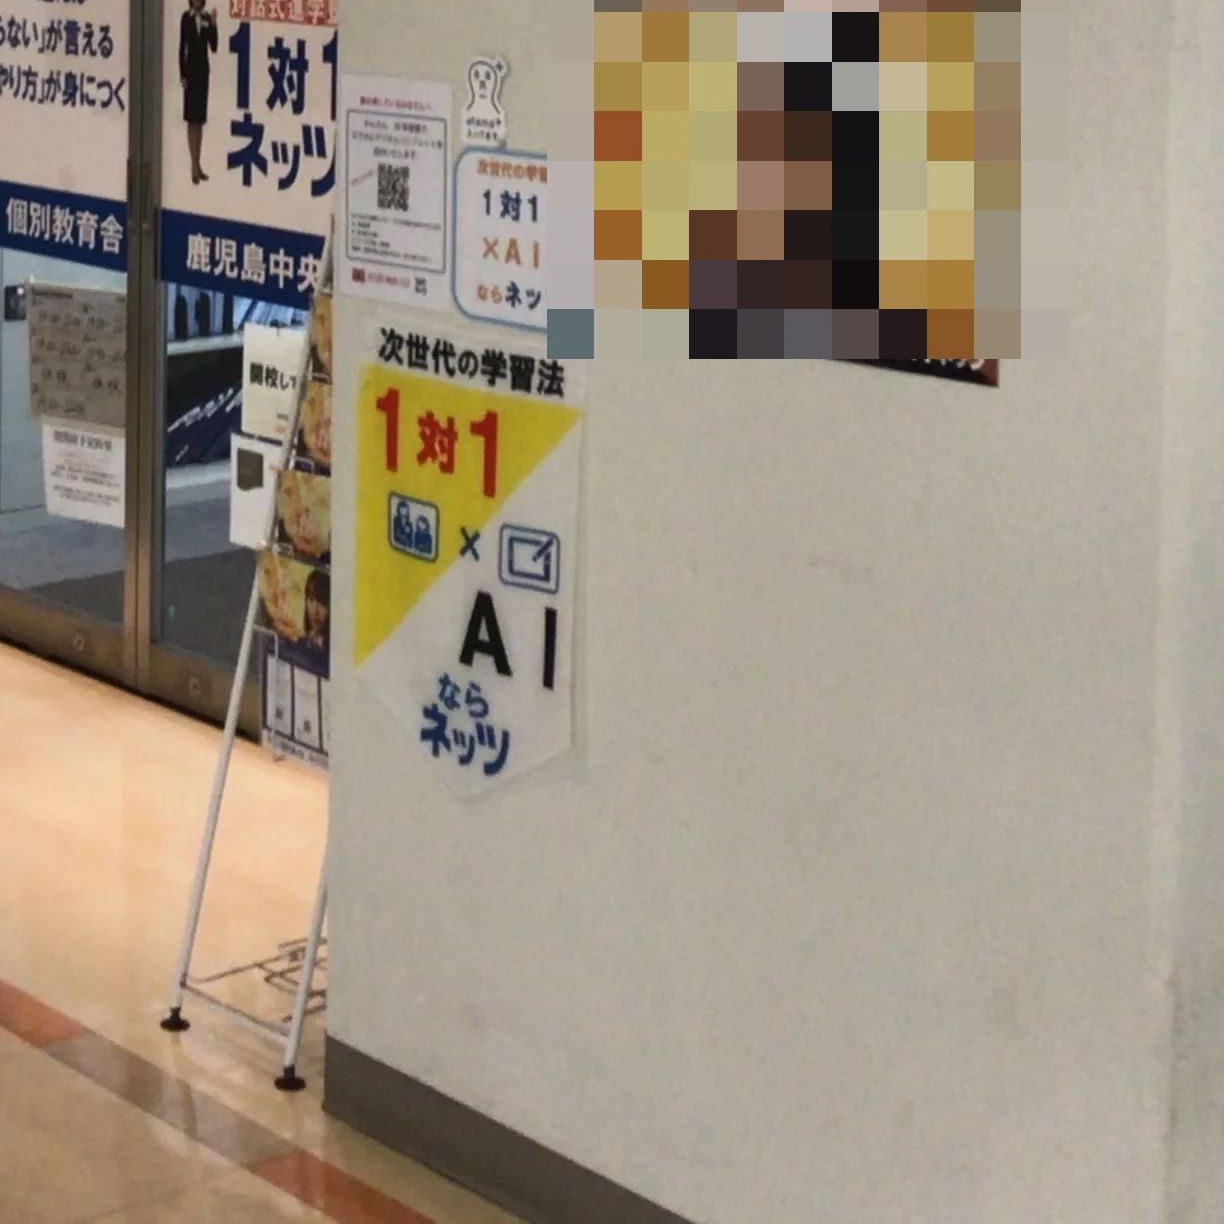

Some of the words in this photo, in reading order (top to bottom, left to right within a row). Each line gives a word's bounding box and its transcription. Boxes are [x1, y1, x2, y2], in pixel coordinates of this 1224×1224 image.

[227, 112, 336, 197] ネッツ
[6, 198, 124, 254] 個別教育舎
[482, 189, 538, 222] 1対1
[378, 328, 565, 398] 次世代の学習法
[376, 387, 499, 499] 1対1
[459, 590, 557, 690] AI
[437, 672, 489, 718] なら
[420, 704, 510, 777] ネッツ
